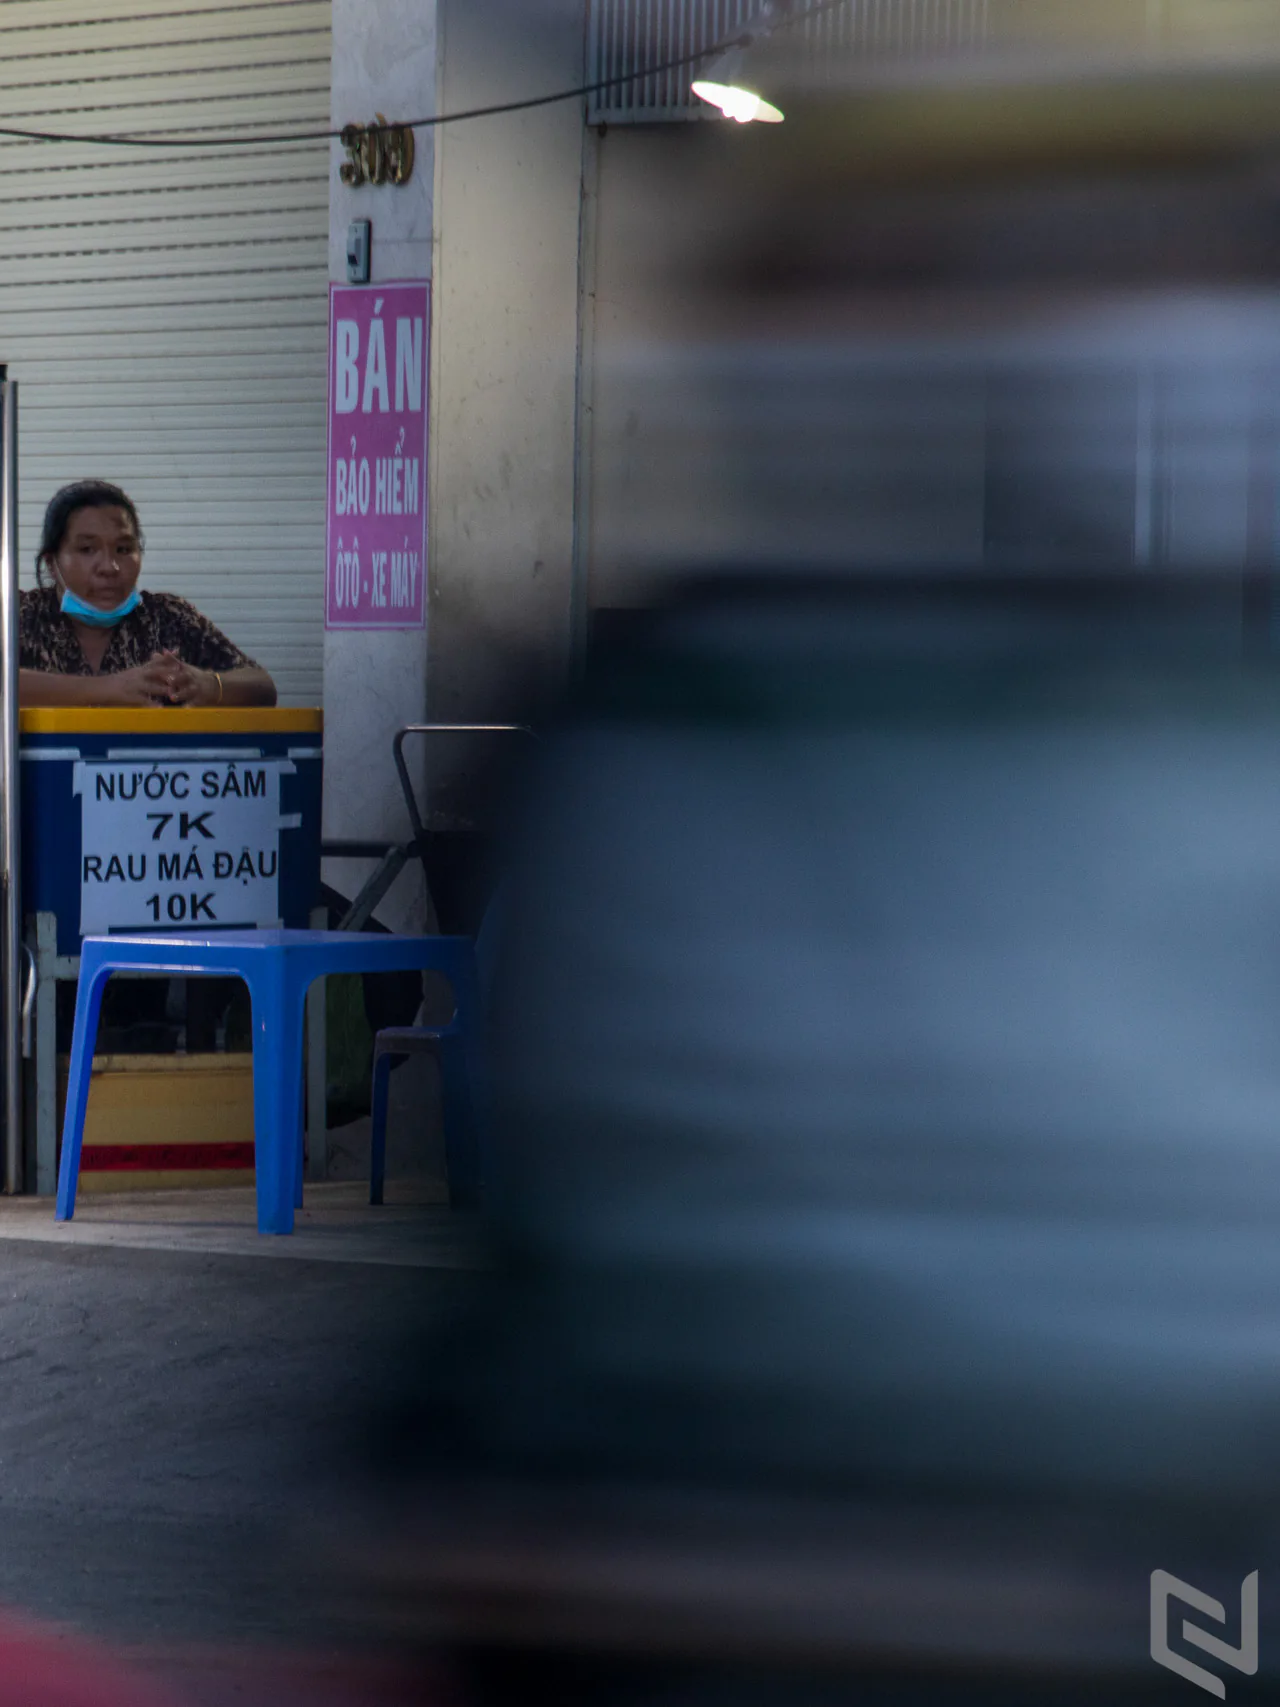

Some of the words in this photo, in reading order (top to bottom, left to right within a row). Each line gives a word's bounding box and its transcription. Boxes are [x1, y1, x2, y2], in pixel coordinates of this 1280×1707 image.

[335, 298, 422, 414] BÁN
[335, 435, 370, 516] BẢO
[375, 426, 419, 516] HIỂM
[335, 536, 360, 609] ÔTÔ
[372, 552, 387, 608] XE
[391, 536, 419, 608] MÁY
[96, 762, 190, 801] NƯỚC
[200, 762, 266, 798] SÂM
[146, 812, 216, 840] 7K
[84, 854, 146, 883] RAU
[158, 845, 204, 881] MÁ
[213, 846, 278, 886] ĐẬU
[146, 892, 217, 922] 10K
